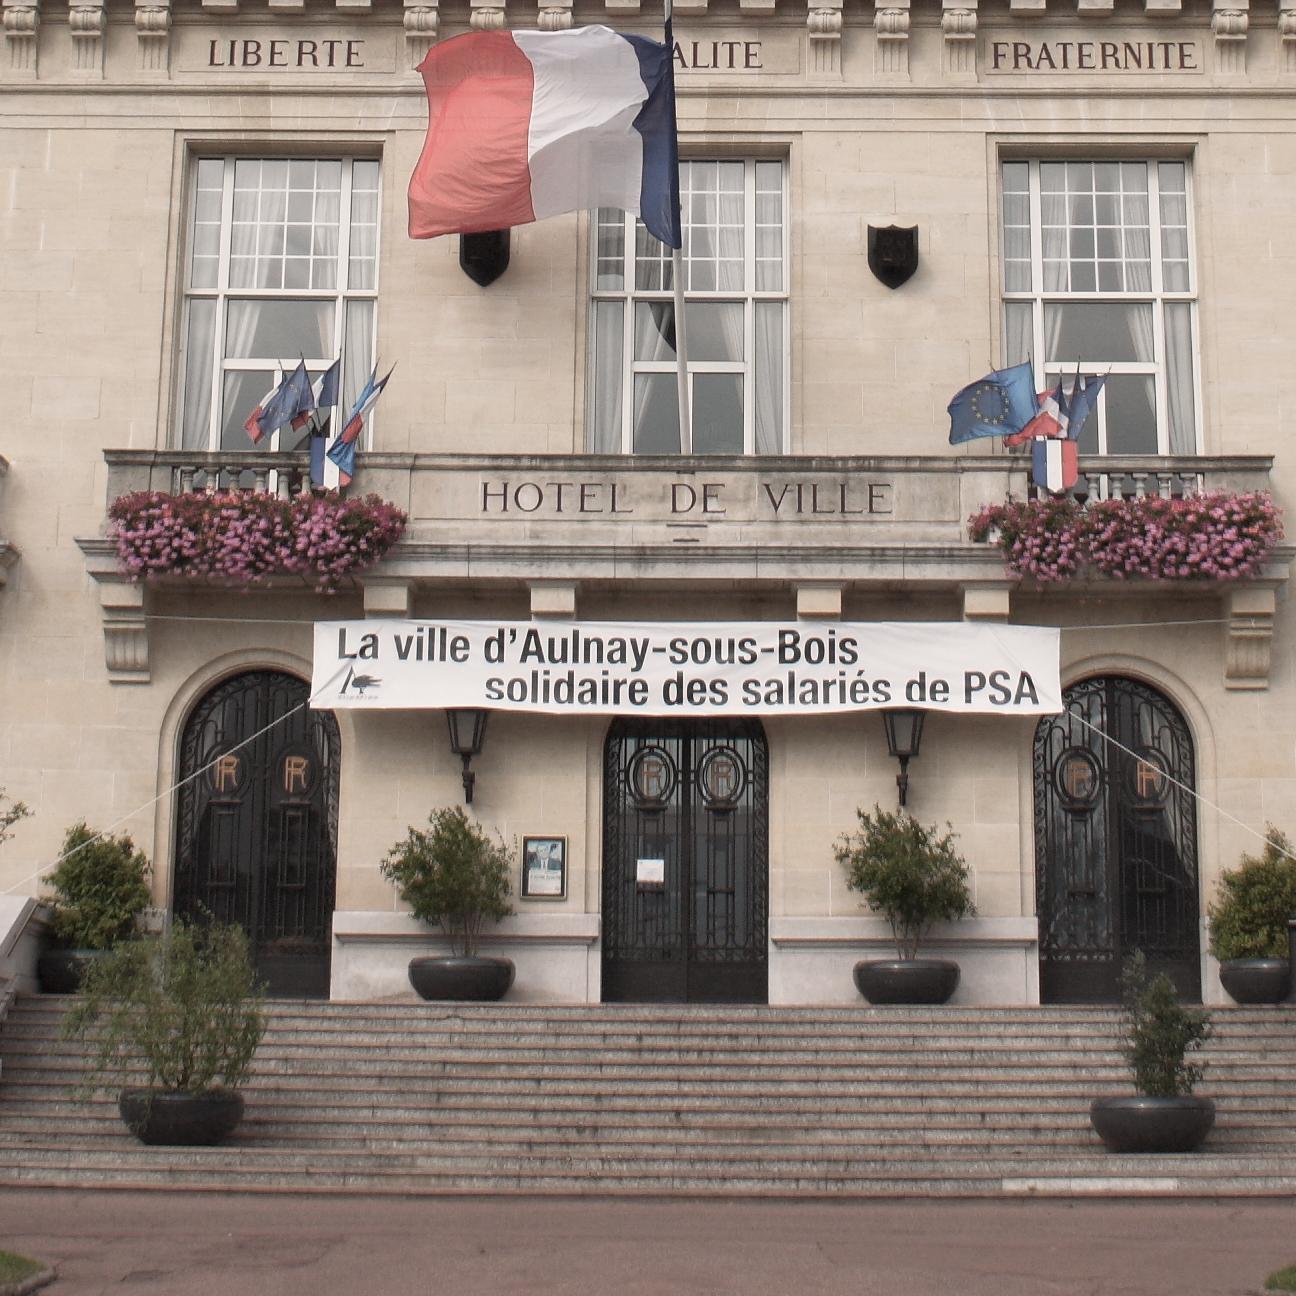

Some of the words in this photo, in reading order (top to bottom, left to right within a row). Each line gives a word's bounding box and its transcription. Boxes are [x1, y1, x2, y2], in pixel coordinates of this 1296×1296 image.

[208, 39, 365, 67] LIBERTE
[672, 40, 764, 69] ALITE
[991, 41, 1198, 70] FRATERNITE
[481, 481, 634, 514] HOTEL
[670, 482, 727, 515] DE
[762, 483, 893, 515] VILLE
[337, 627, 380, 661] La
[392, 627, 471, 663] ville
[484, 627, 860, 673] d'Aulnay-sous-Bois
[485, 669, 650, 706] solidaire
[662, 671, 730, 706] des
[741, 669, 893, 706] salariés
[904, 671, 951, 703] de
[963, 670, 1040, 705] PSA
